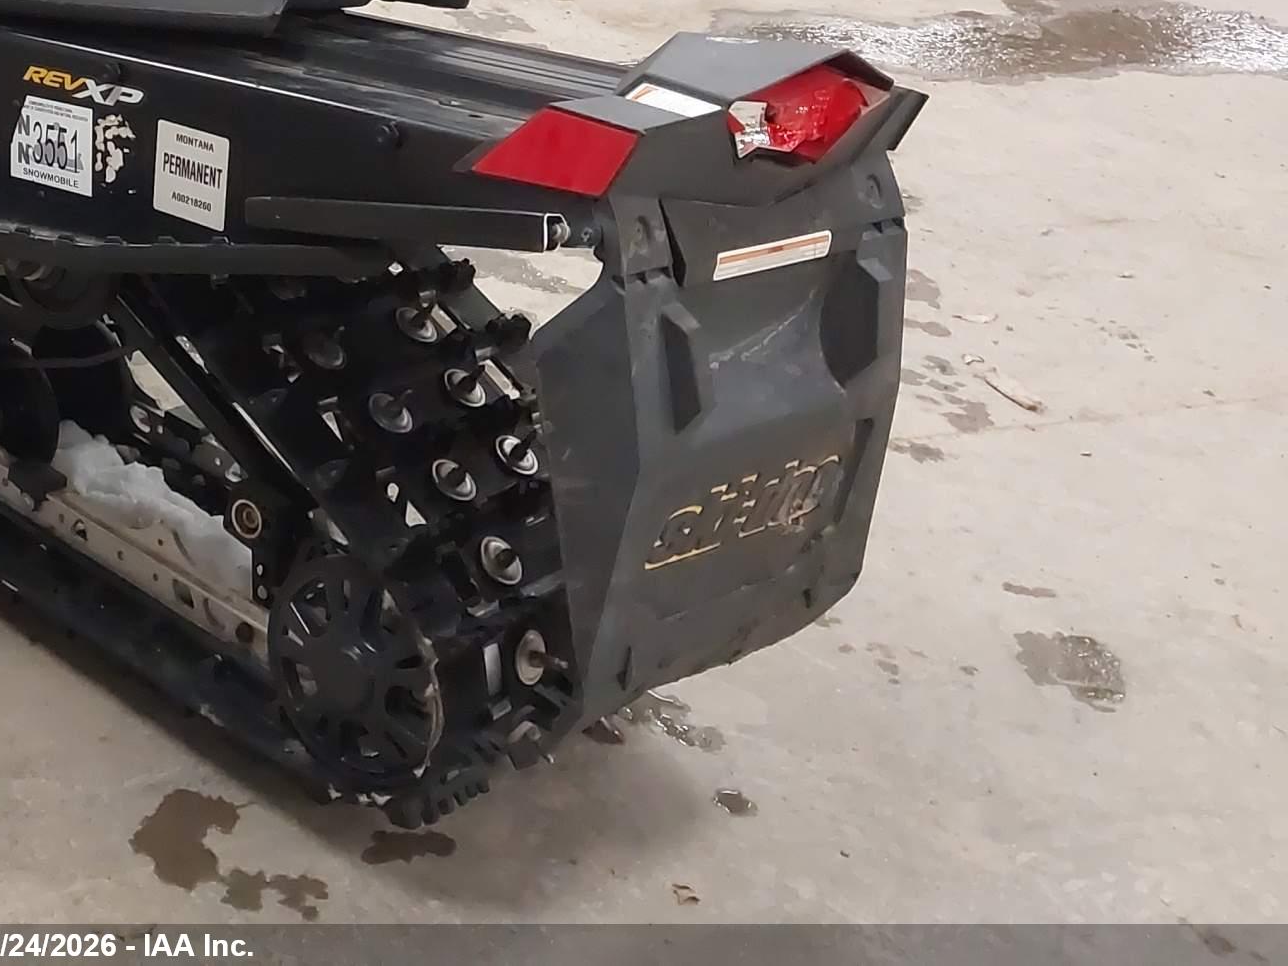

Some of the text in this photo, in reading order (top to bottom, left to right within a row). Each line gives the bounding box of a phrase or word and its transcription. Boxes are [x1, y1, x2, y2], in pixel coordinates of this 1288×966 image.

[32, 121, 79, 174] 3551
[176, 133, 215, 153] MONTANA
[22, 166, 80, 189] SNOWMOBILE
[162, 152, 223, 190] PERMANENT
